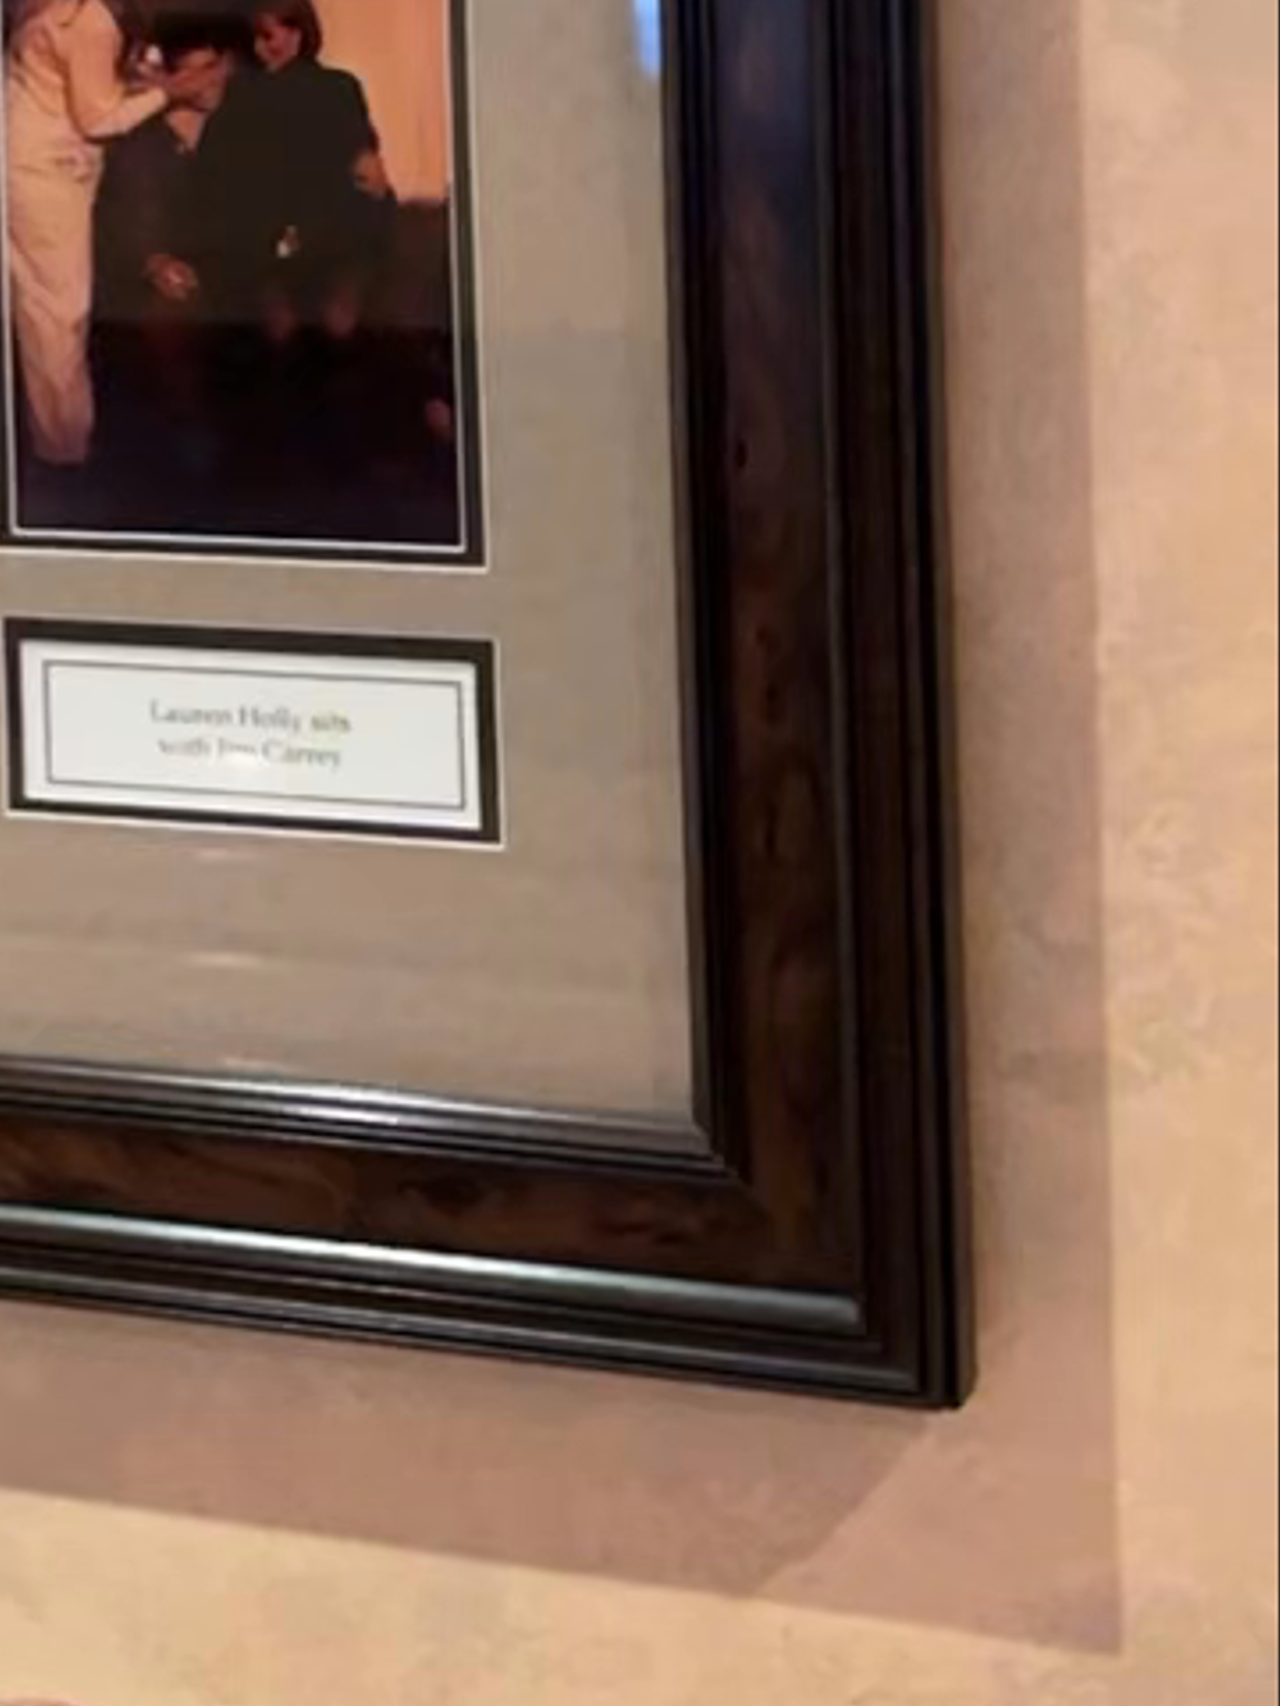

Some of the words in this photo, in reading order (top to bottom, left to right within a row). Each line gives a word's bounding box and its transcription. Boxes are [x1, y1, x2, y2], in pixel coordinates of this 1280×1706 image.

[149, 699, 233, 725] Lauren
[237, 705, 301, 734] Holly
[156, 736, 213, 756] with
[260, 738, 341, 767] Carrey
